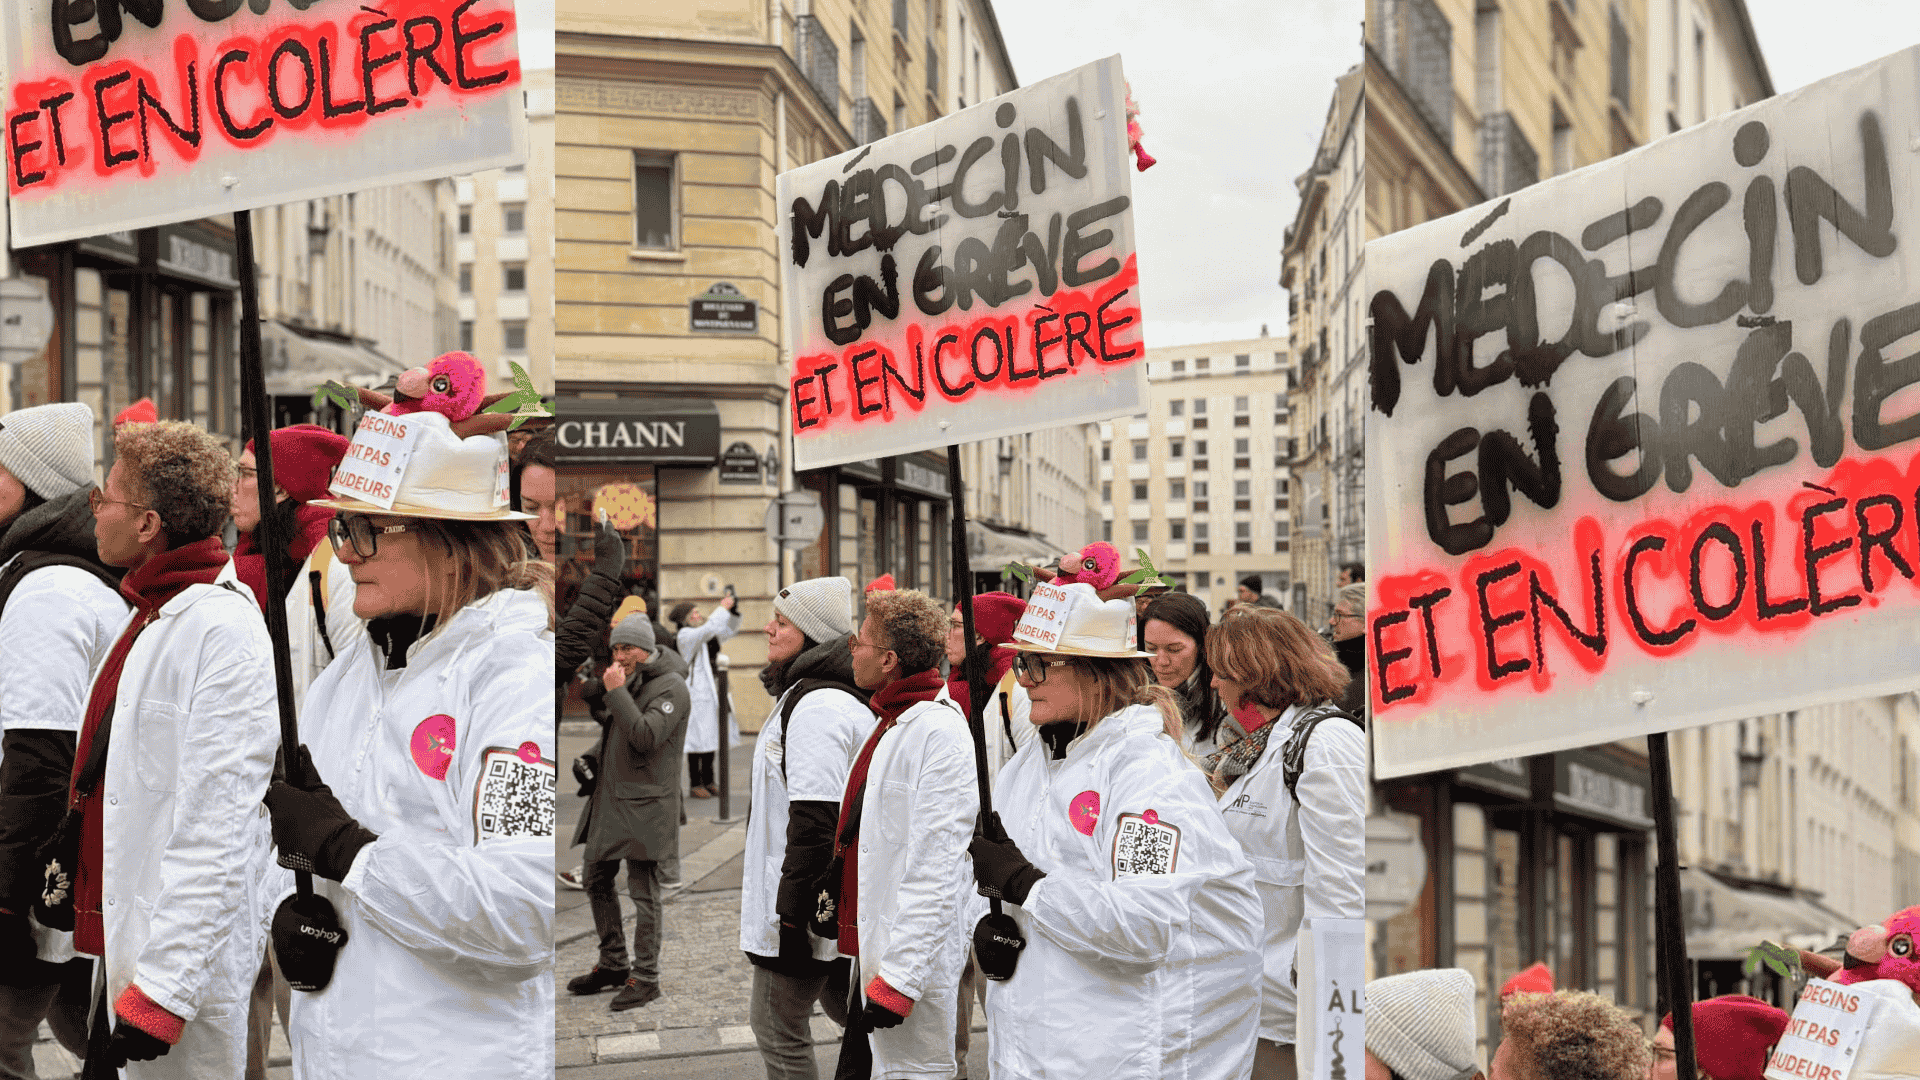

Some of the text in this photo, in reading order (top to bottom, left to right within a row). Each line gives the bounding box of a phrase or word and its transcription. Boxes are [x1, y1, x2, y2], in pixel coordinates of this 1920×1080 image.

[9, 91, 74, 187] ET
[790, 96, 1087, 268] MÉDECIN
[1368, 109, 1898, 417] MÉDECIN
[822, 254, 899, 346] EN
[794, 363, 838, 429] ET
[363, 445, 391, 467] PAS
[555, 421, 686, 449] CHANN
[1424, 391, 1562, 556] EN
[1036, 605, 1056, 621] PAS
[1373, 587, 1452, 704] ET
[1623, 481, 1920, 646] COLÈR
[300, 924, 342, 944] Kaytan
[1328, 979, 1346, 1013] À
[1806, 1022, 1840, 1047] PAS
